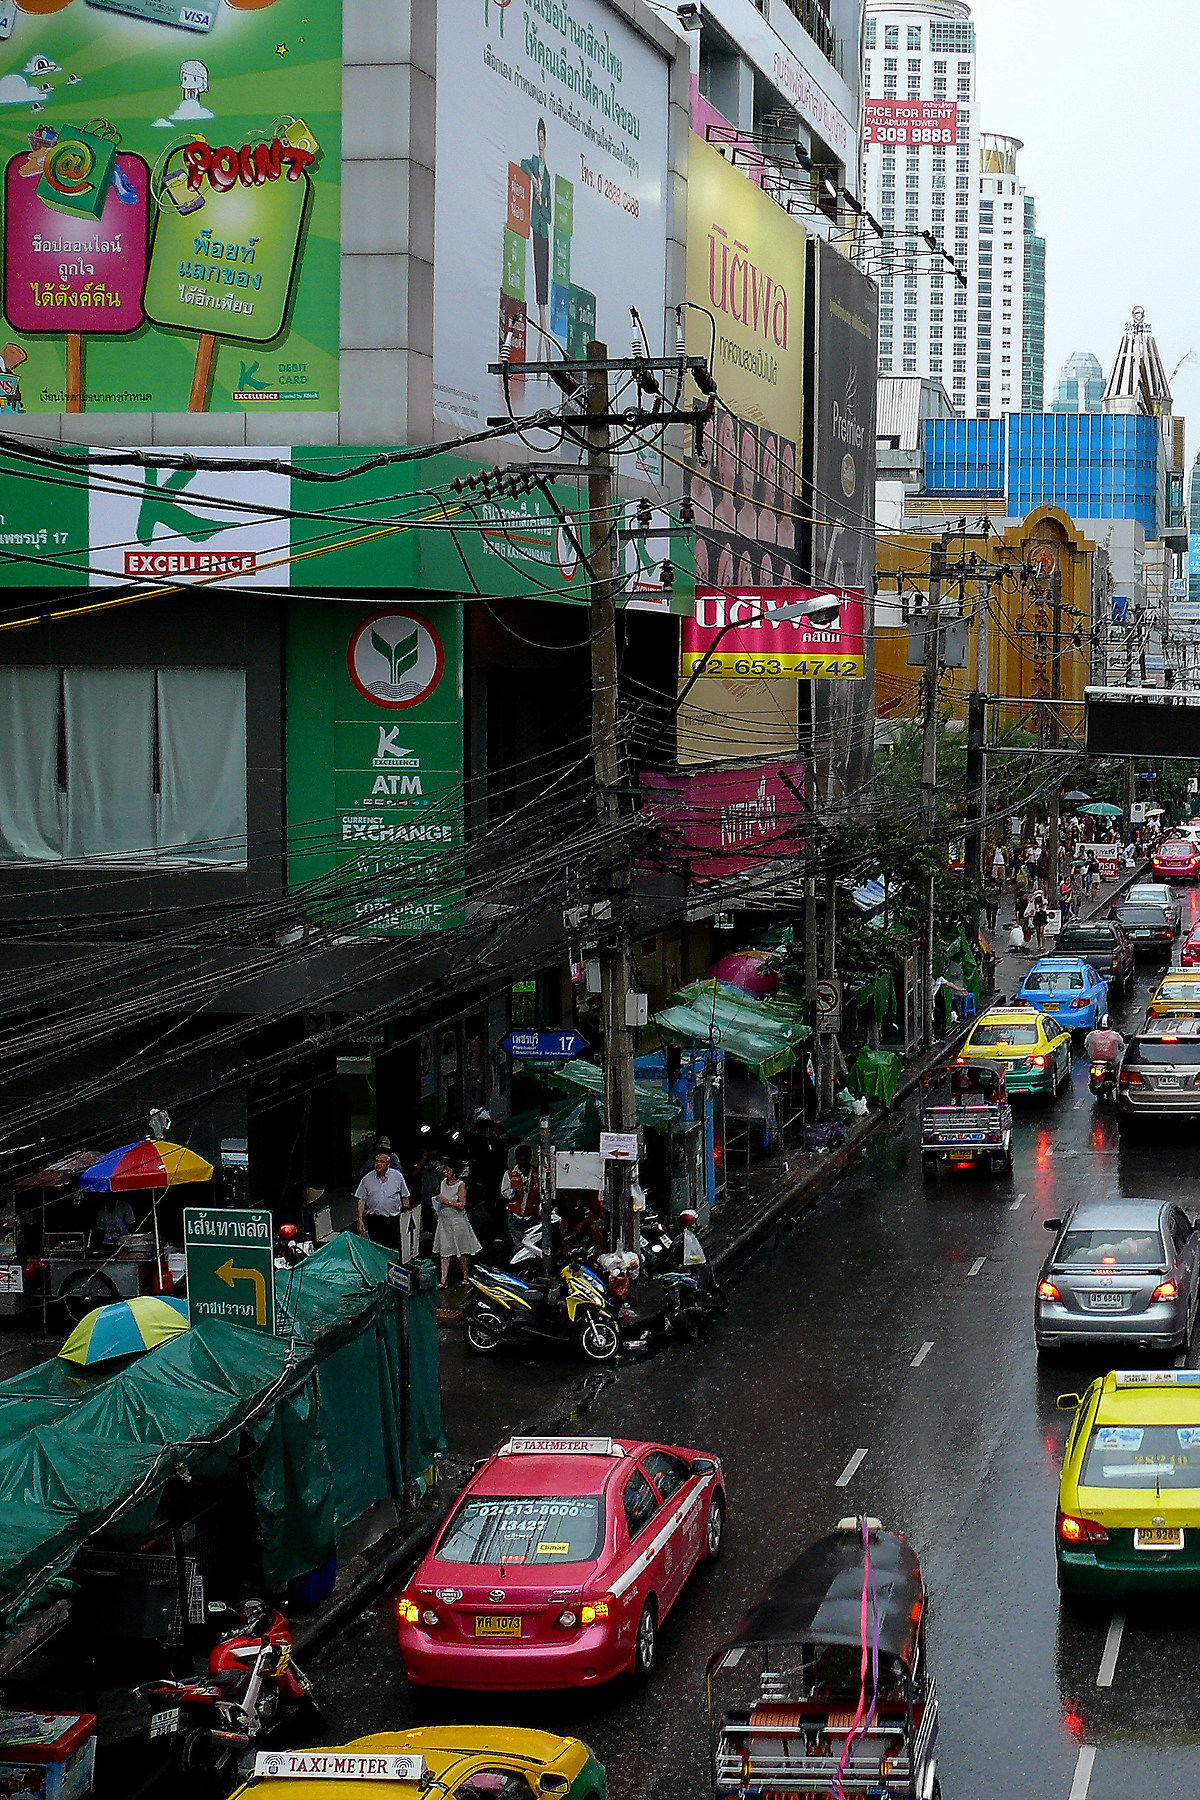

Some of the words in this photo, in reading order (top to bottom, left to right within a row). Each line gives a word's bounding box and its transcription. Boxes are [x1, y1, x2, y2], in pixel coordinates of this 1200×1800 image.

[184, 10, 209, 26] VISA
[864, 107, 891, 117] FFICE
[896, 108, 919, 118] FOR
[922, 109, 953, 119] RENT
[866, 118, 908, 126] PALLADIUM
[911, 119, 938, 127] TOWER
[877, 127, 907, 142] 309
[911, 128, 952, 143] 9888
[183, 137, 315, 193] POINT
[597, 174, 603, 194] 0
[31, 232, 122, 254] ช็อปออนไลน์
[193, 228, 259, 264] พ็อยท์
[58, 257, 95, 282] ถูกใจ
[178, 258, 262, 290] แลกของ
[30, 281, 121, 308] ได้ตังค์คืน
[178, 283, 255, 316] ได้อีกเพียบ
[278, 363, 308, 373] DEBIT
[278, 375, 308, 385] CARD
[53, 532, 69, 545] 17
[129, 554, 252, 573] EXCELLENCE
[692, 658, 857, 677] 02-653-4742
[374, 759, 419, 767] EXCELLENCE
[371, 775, 422, 795] ATM
[342, 816, 384, 824] CURRENCY
[342, 825, 452, 842] EXCHANGE
[512, 1032, 539, 1045] เพชรบุรี
[559, 1036, 574, 1050] 17
[938, 1132, 985, 1141] THAILAND
[187, 1212, 269, 1238] เส้นทางลัด
[523, 1440, 589, 1450] TAXI-METER
[479, 1504, 579, 1518] 02-613-8000
[498, 1520, 547, 1531] 13427
[540, 1544, 567, 1552] Climax
[496, 1617, 520, 1629] 1073
[288, 1756, 388, 1775] TAXI-METER
